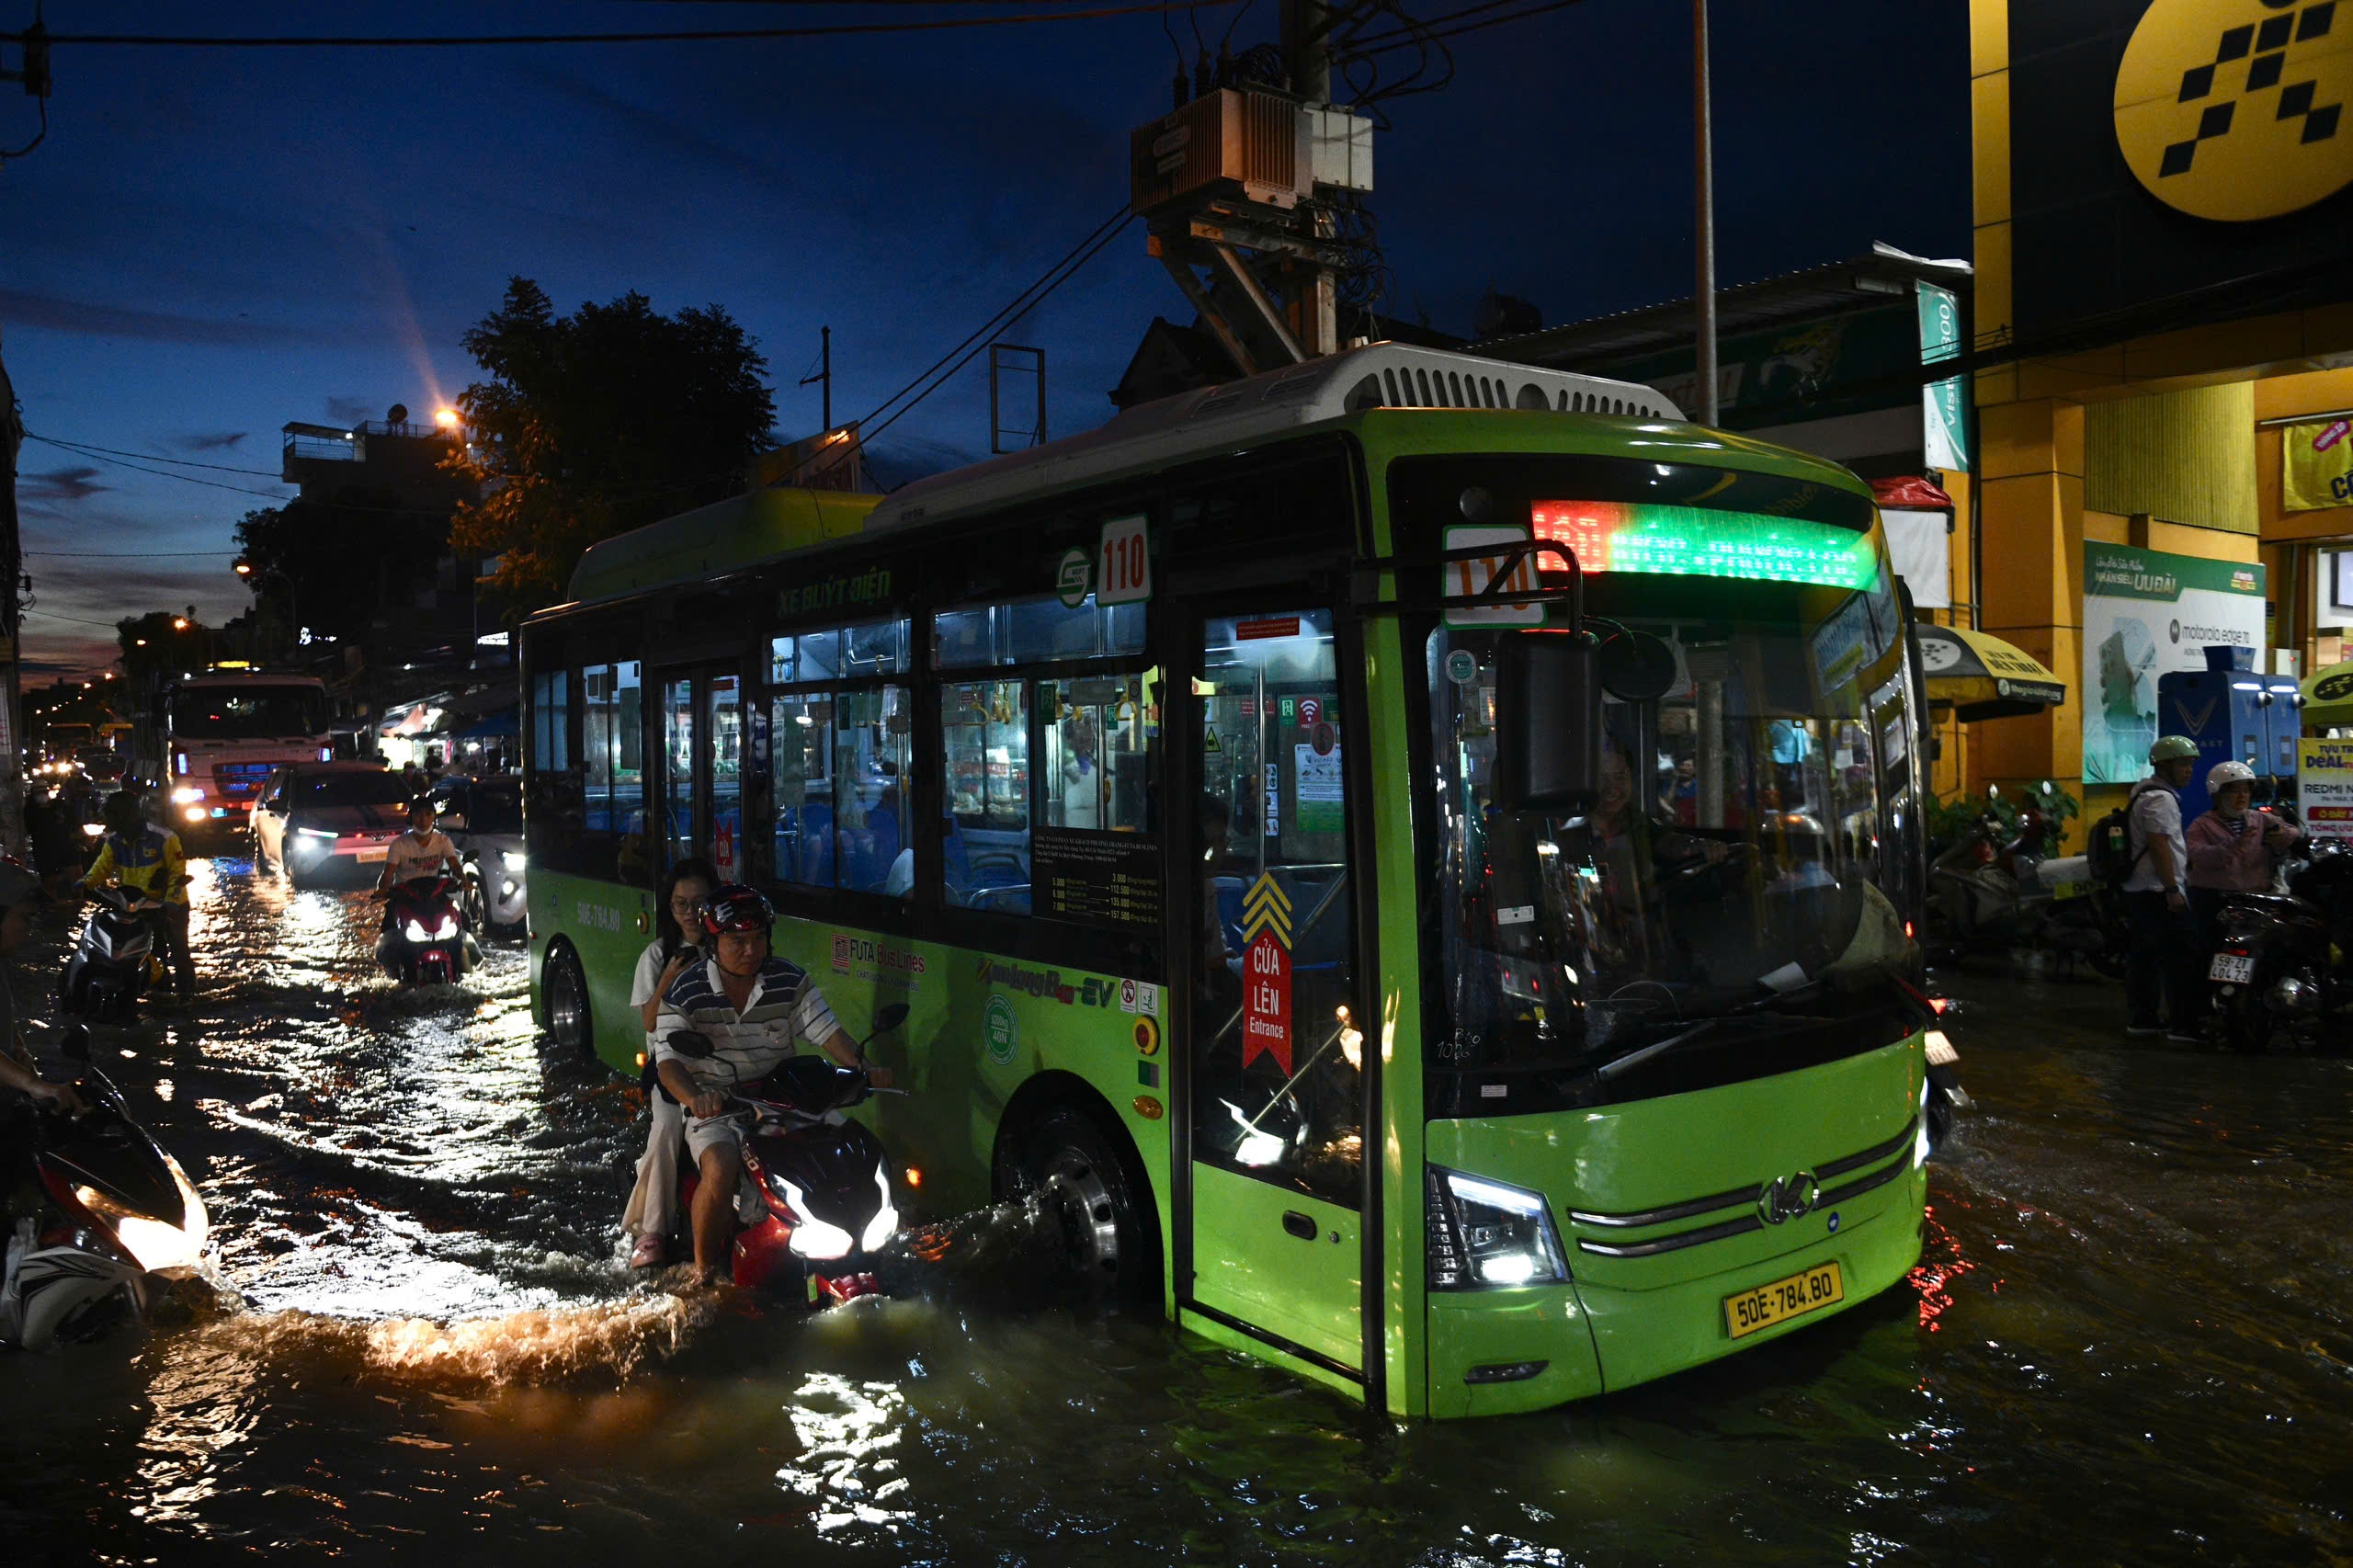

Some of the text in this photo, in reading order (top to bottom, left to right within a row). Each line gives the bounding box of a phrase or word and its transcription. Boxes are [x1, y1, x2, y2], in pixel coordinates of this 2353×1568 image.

[1105, 534, 1143, 591] 110
[1455, 551, 1529, 610] 110
[2182, 624, 2220, 642] motorola
[2222, 628, 2242, 646] edge
[2304, 784, 2342, 793] REDMI
[850, 938, 875, 963] FUTA
[1254, 938, 1279, 976] CỬA
[1254, 981, 1279, 1016] LÊN
[1250, 1017, 1284, 1040] Entrance
[1736, 1272, 1833, 1327] 50E-784.80
